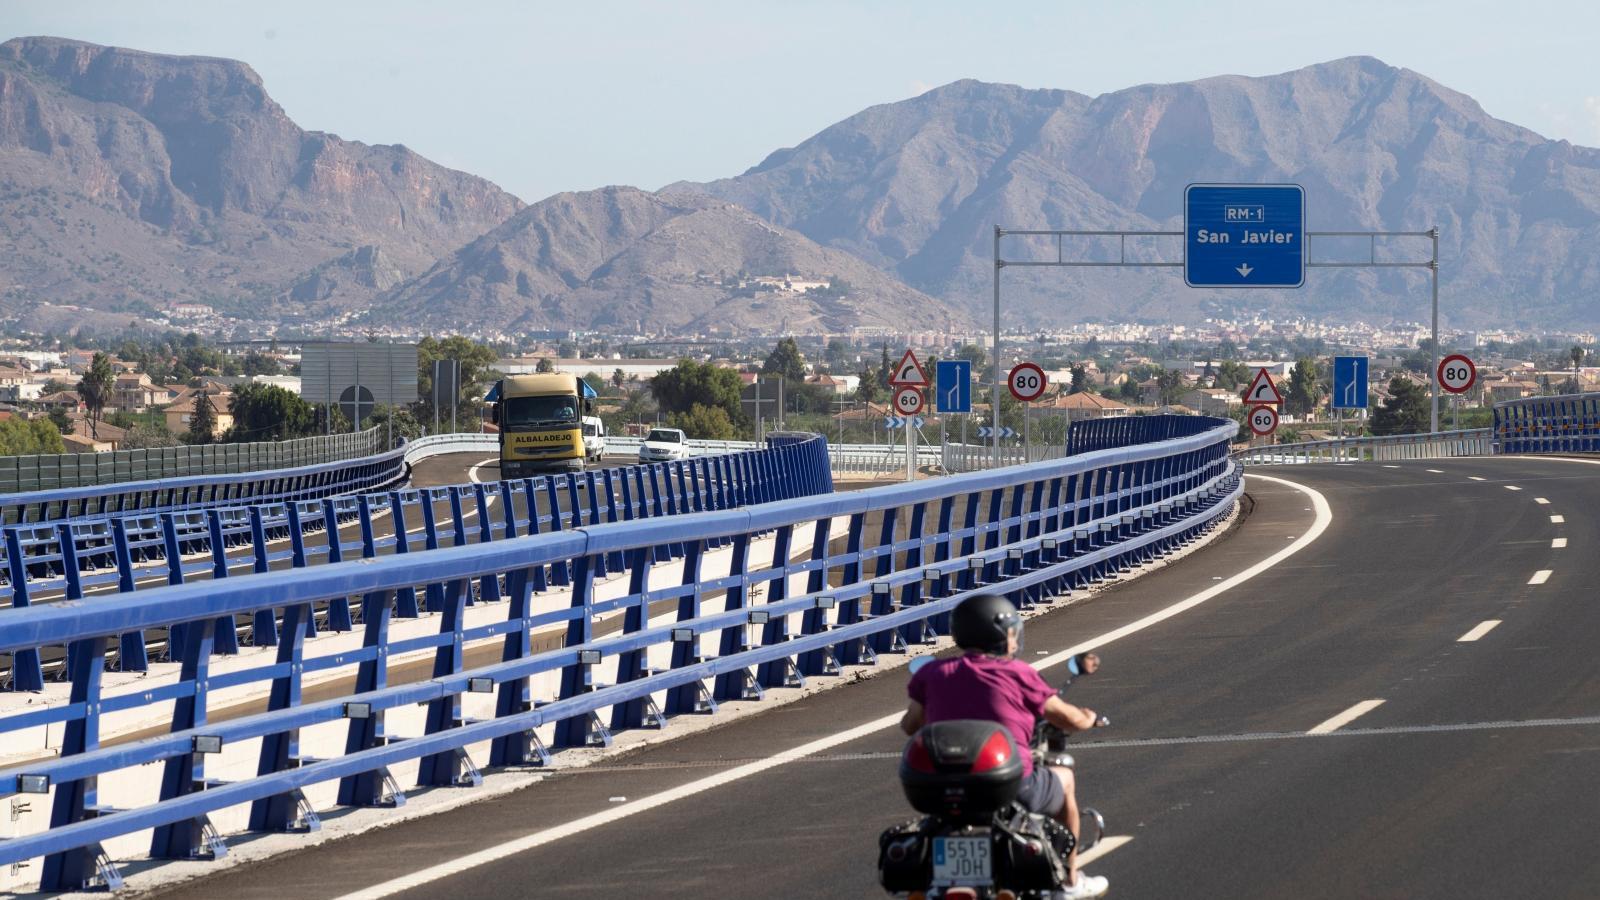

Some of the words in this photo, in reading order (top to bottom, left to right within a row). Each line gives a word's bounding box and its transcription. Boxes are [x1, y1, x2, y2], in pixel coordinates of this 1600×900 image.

[1228, 208, 1262, 219] RM-1
[1197, 229, 1229, 243] San
[1241, 229, 1293, 243] Javier
[1446, 368, 1468, 380] 80
[1016, 376, 1038, 388] 80
[901, 396, 918, 406] 60
[1254, 415, 1271, 425] 60
[515, 434, 572, 443] ALBALADEJO
[947, 840, 988, 858] 5515
[951, 859, 983, 876] JDH
